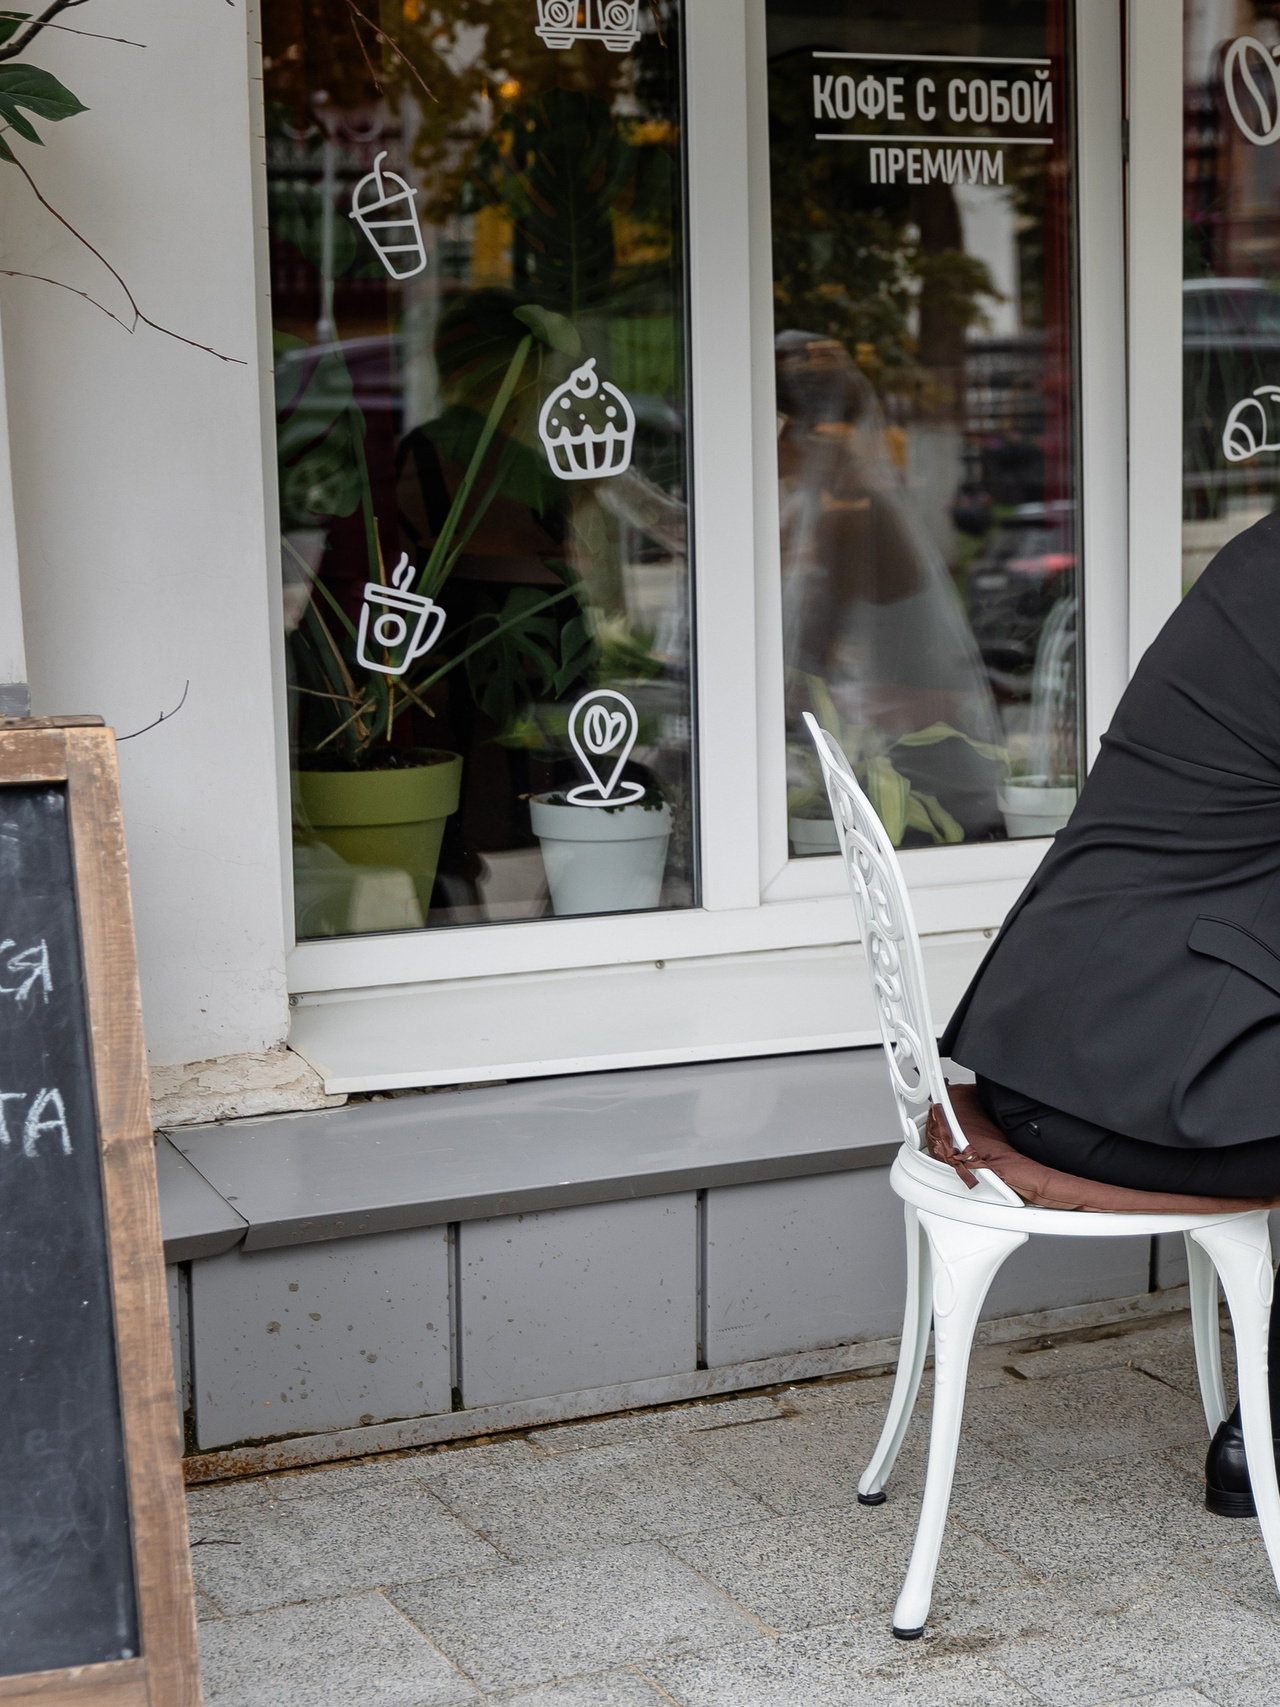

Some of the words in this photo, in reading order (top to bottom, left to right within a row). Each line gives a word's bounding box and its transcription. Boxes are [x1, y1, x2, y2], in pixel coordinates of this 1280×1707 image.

[812, 75, 905, 120] КОФЕ
[916, 77, 937, 121] С
[948, 69, 1054, 124] СОБОЙ
[869, 147, 1004, 185] ПРЕМИУМ
